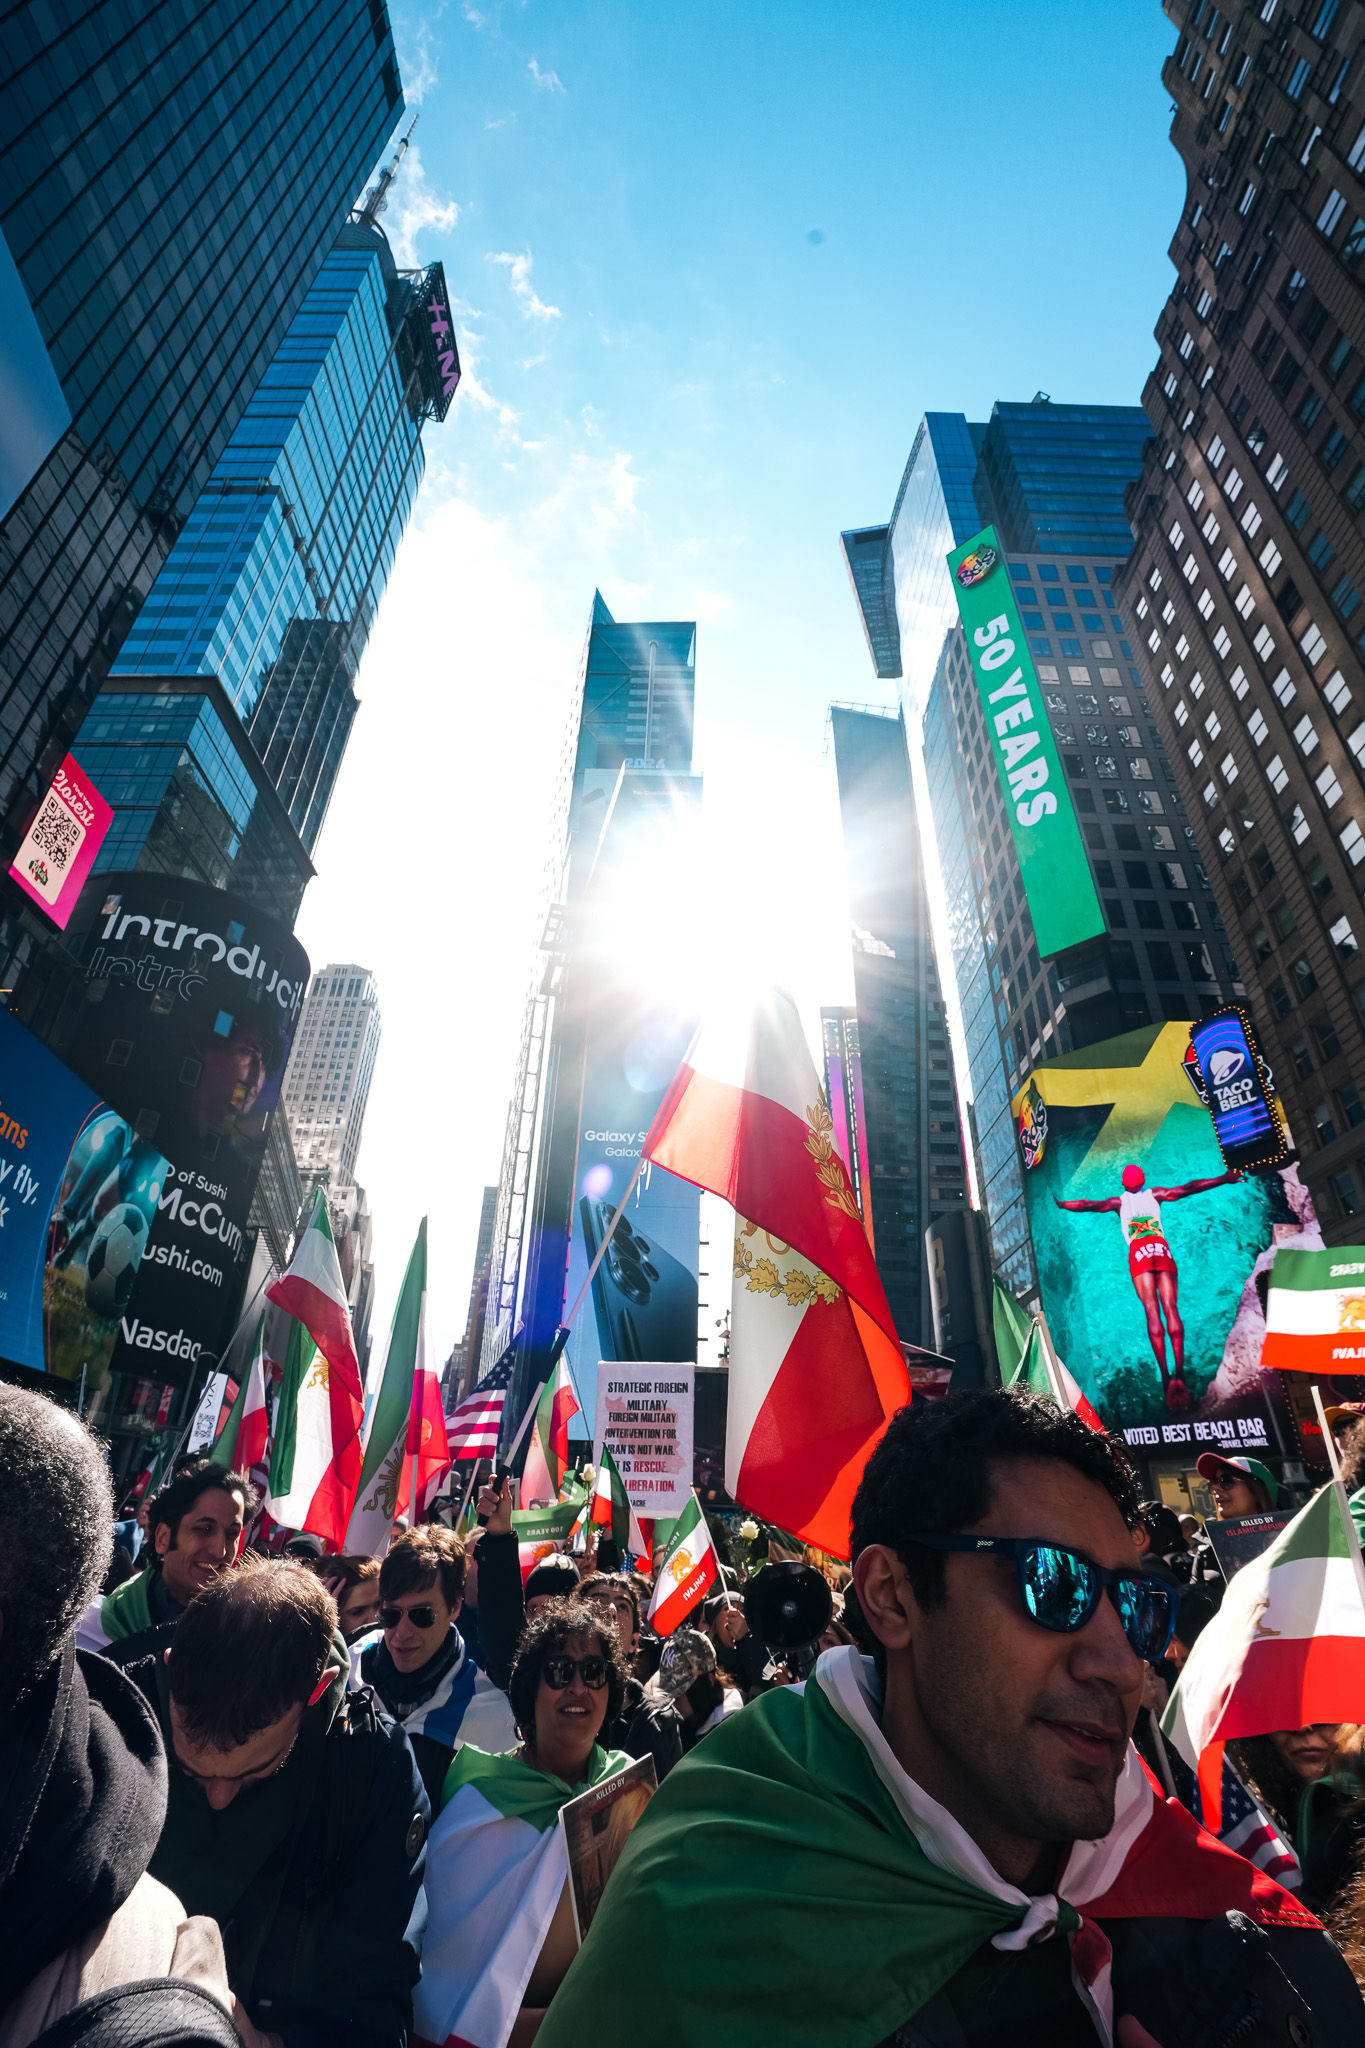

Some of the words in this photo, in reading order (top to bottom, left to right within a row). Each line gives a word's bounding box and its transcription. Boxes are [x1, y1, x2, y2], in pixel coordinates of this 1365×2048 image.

[973, 613, 1016, 672] 50
[988, 666, 1057, 827] YEARS
[1213, 1078, 1253, 1101] TACO
[1219, 1090, 1258, 1112] BELL
[584, 1130, 636, 1145] Galaxy
[637, 1131, 649, 1142] S
[605, 1147, 642, 1158] Galax
[178, 1171, 196, 1184] of
[195, 1175, 228, 1200] Sushi
[141, 1243, 223, 1287] ushi.com
[607, 1382, 652, 1394] STRATEGIC
[654, 1382, 689, 1394] FOREIGN
[626, 1400, 668, 1411] MILITARY
[608, 1412, 638, 1423] FOREIGN
[640, 1413, 677, 1423] MILITARY
[607, 1428, 661, 1439] INTERVENTION
[662, 1429, 676, 1439] FOR
[1123, 1427, 1159, 1446] VOTED
[1161, 1424, 1191, 1443] BEST
[1193, 1420, 1236, 1441] BEACH
[1236, 1417, 1267, 1437] BAR
[607, 1444, 626, 1455] IRAN
[628, 1444, 636, 1455] IS
[637, 1444, 653, 1455] NOT
[655, 1445, 675, 1456] WAR.
[622, 1461, 631, 1472] IS
[633, 1461, 668, 1473] RESCUE.
[624, 1479, 676, 1492] LIBERATION.
[630, 1499, 646, 1508] ACRE
[1240, 1518, 1263, 1527] KILLED
[1225, 1526, 1258, 1536] ISLAMIC
[595, 1782, 617, 1801] KILLED
[617, 1776, 625, 1787] BY
